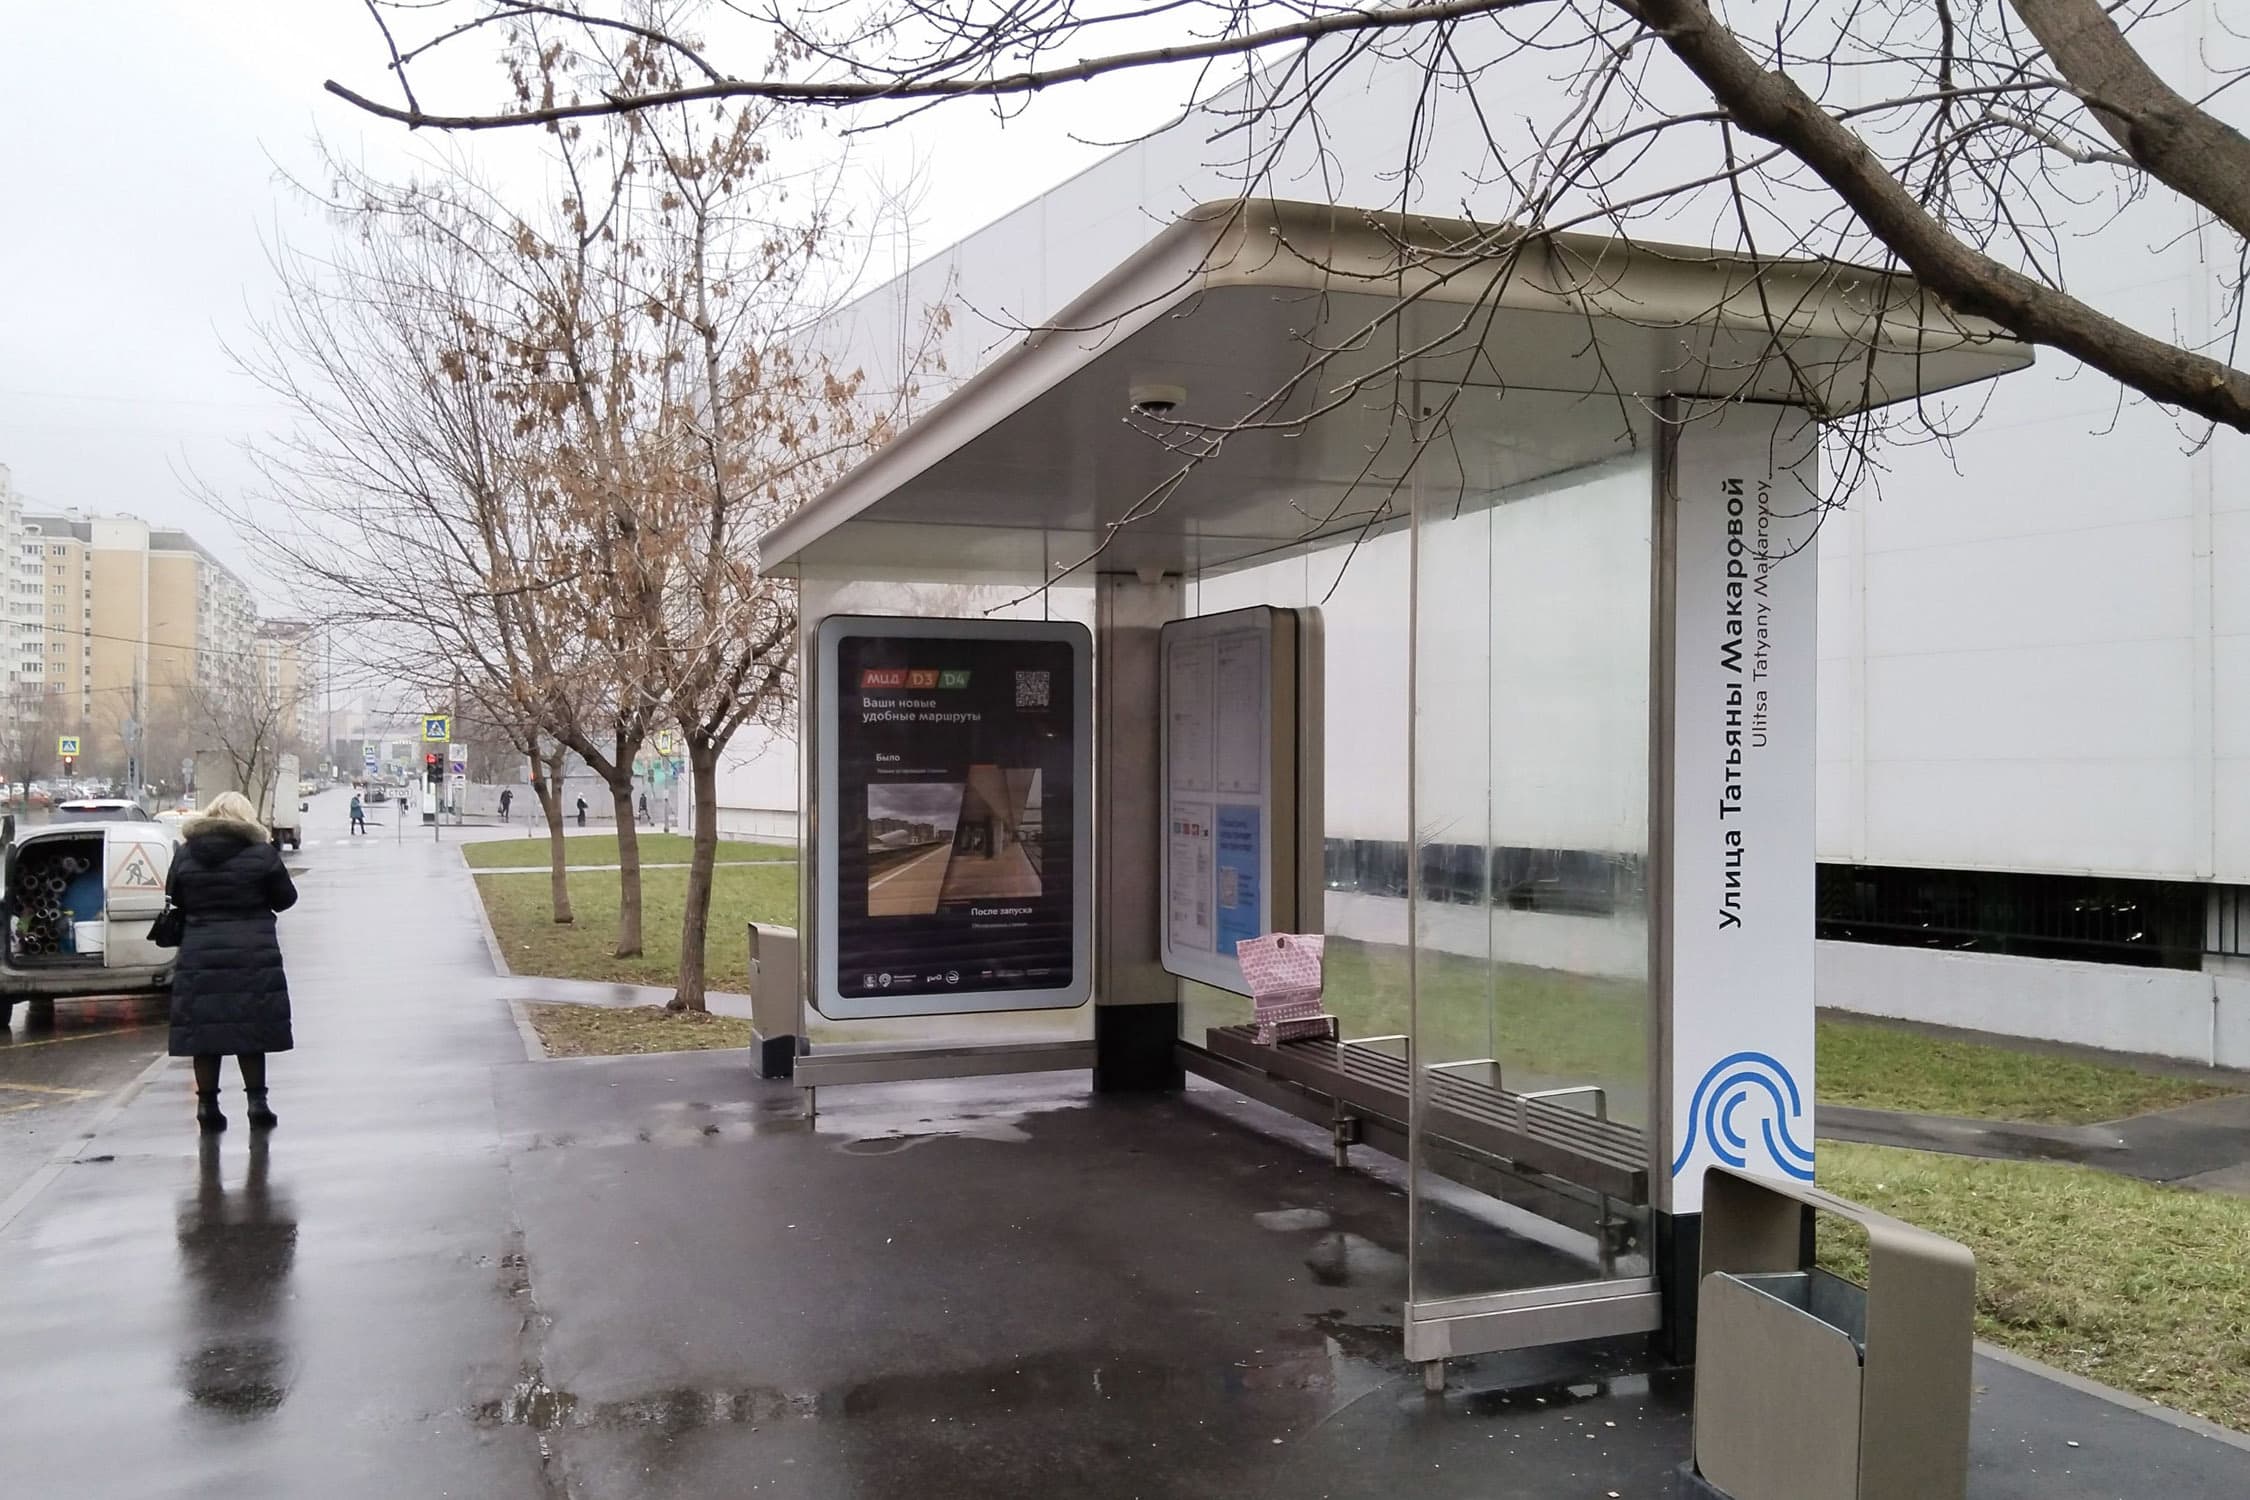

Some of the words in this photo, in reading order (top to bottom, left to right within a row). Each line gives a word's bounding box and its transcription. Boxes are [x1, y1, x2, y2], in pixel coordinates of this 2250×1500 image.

[1752, 480, 1772, 598] Makarovoy
[1721, 478, 1747, 674] Макаровой
[1752, 602, 1771, 683] Tatyany
[863, 697, 896, 709] Ваши
[899, 699, 936, 709] новые
[867, 673, 901, 685] МЦД
[913, 673, 934, 685] D3
[945, 673, 965, 685] D4
[863, 710, 916, 724] удобные
[919, 712, 982, 723] маршруты
[1752, 690, 1768, 748] Ulitsa
[876, 753, 900, 762] Было
[1719, 684, 1743, 820] Татьяны
[1719, 831, 1744, 930] Улица
[971, 907, 997, 916] После
[1000, 907, 1033, 917] запуска
